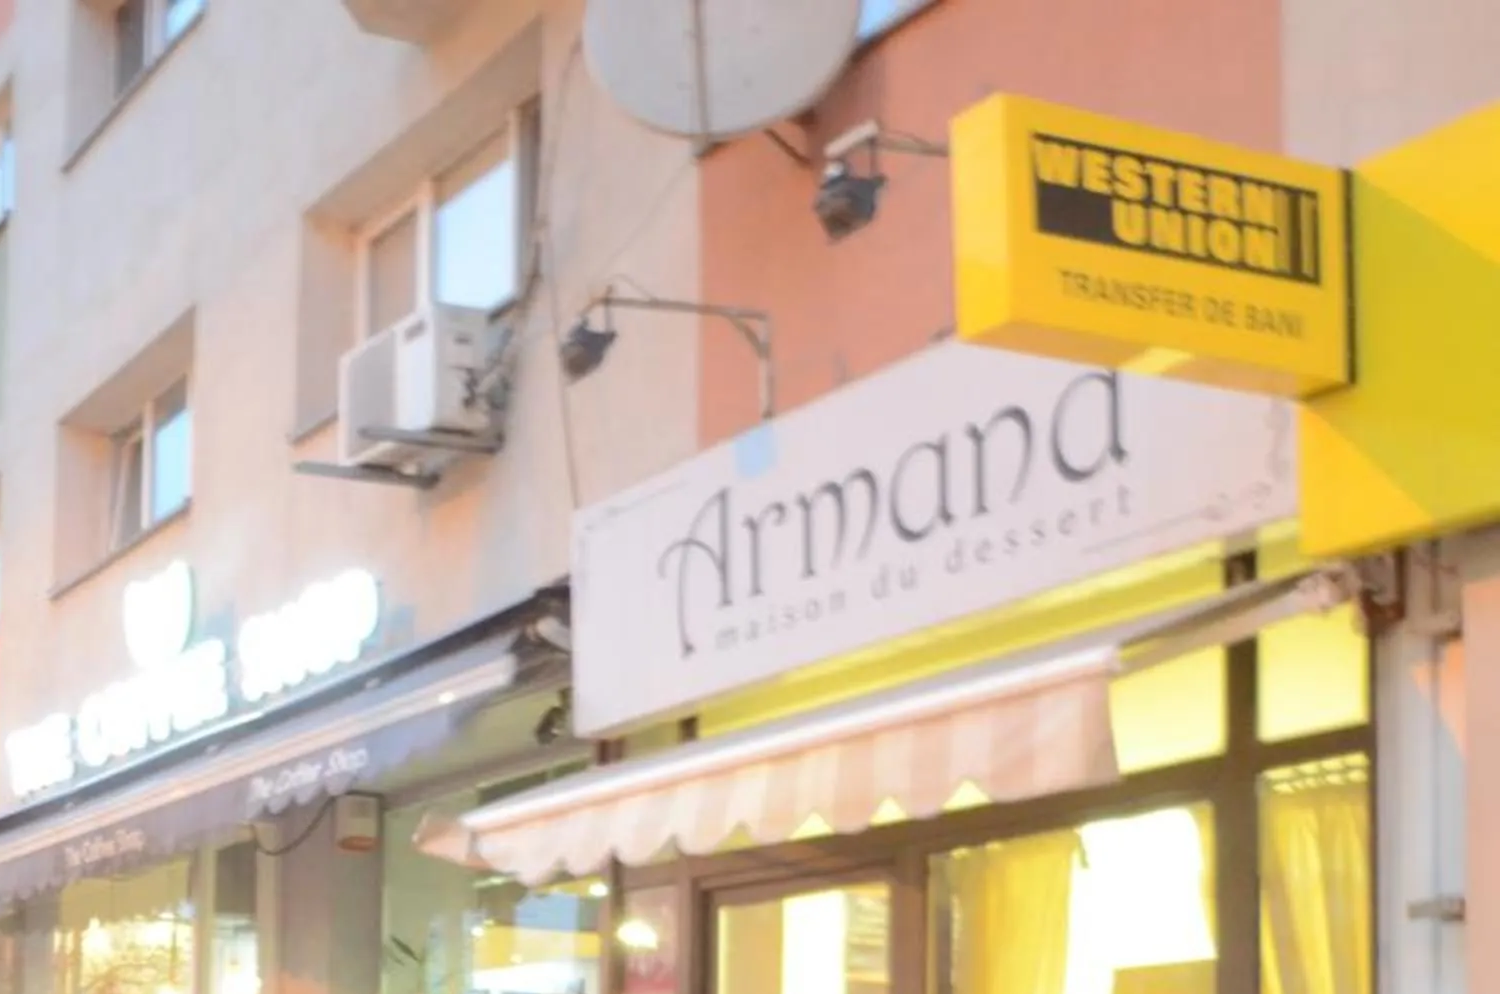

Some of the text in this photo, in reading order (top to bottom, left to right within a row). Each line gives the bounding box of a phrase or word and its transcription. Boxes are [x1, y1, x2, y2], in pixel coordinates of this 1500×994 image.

[1033, 142, 1279, 229] WESTERN
[1111, 199, 1279, 272] UNION
[1057, 268, 1306, 340] TRANSFER DE BANI
[657, 370, 1131, 660] Armand
[714, 482, 1136, 651] maison du dessert
